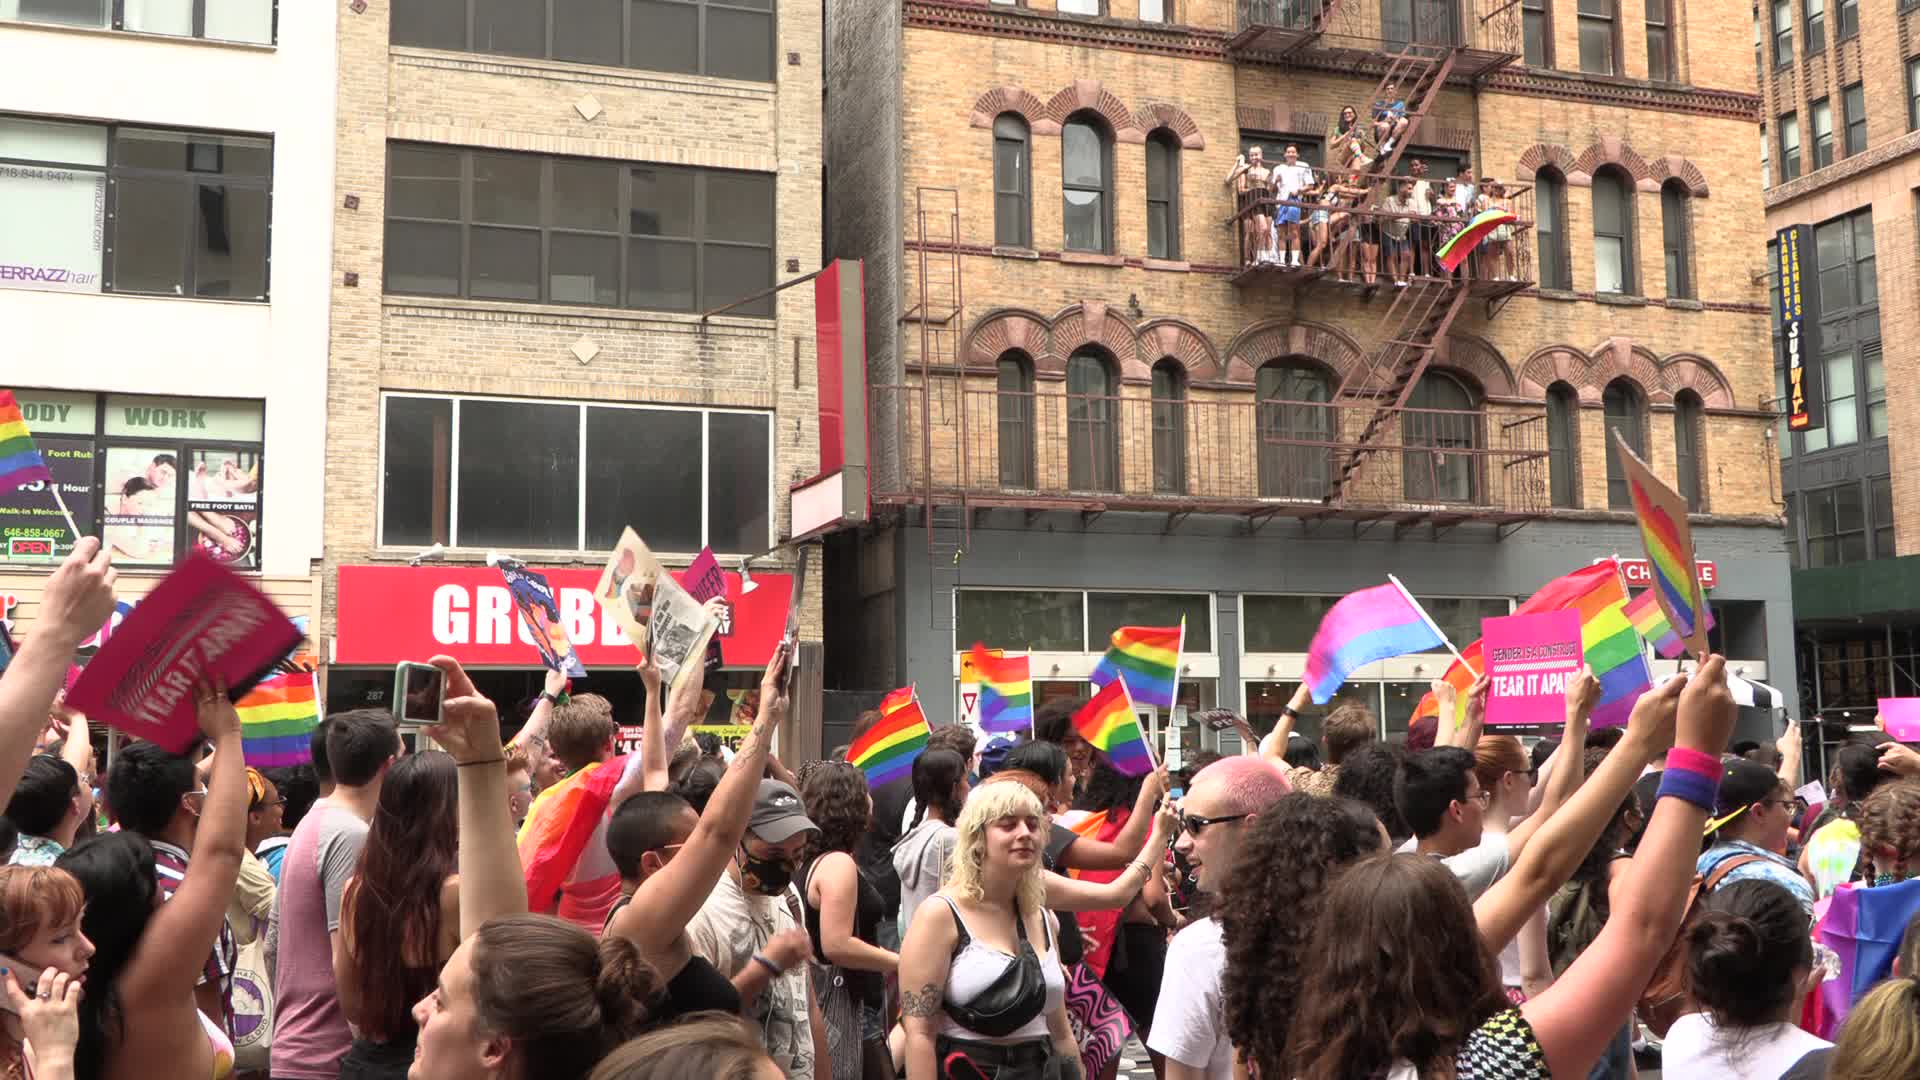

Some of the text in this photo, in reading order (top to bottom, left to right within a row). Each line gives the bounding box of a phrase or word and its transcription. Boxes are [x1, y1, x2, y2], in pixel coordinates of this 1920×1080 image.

[1781, 232, 1791, 310] LAUNDRY
[1790, 229, 1802, 316] CLEANERS
[1788, 321, 1804, 415] SUBWAY
[125, 407, 207, 429] WORK
[47, 449, 71, 458] Foot
[73, 450, 94, 459] Rub
[63, 483, 90, 492] Hour
[4, 527, 65, 538] 646-858-0667
[12, 540, 51, 554] OPEN
[1493, 647, 1521, 661] GENDER
[1492, 675, 1525, 697] TEAR
[1527, 674, 1539, 696] IT
